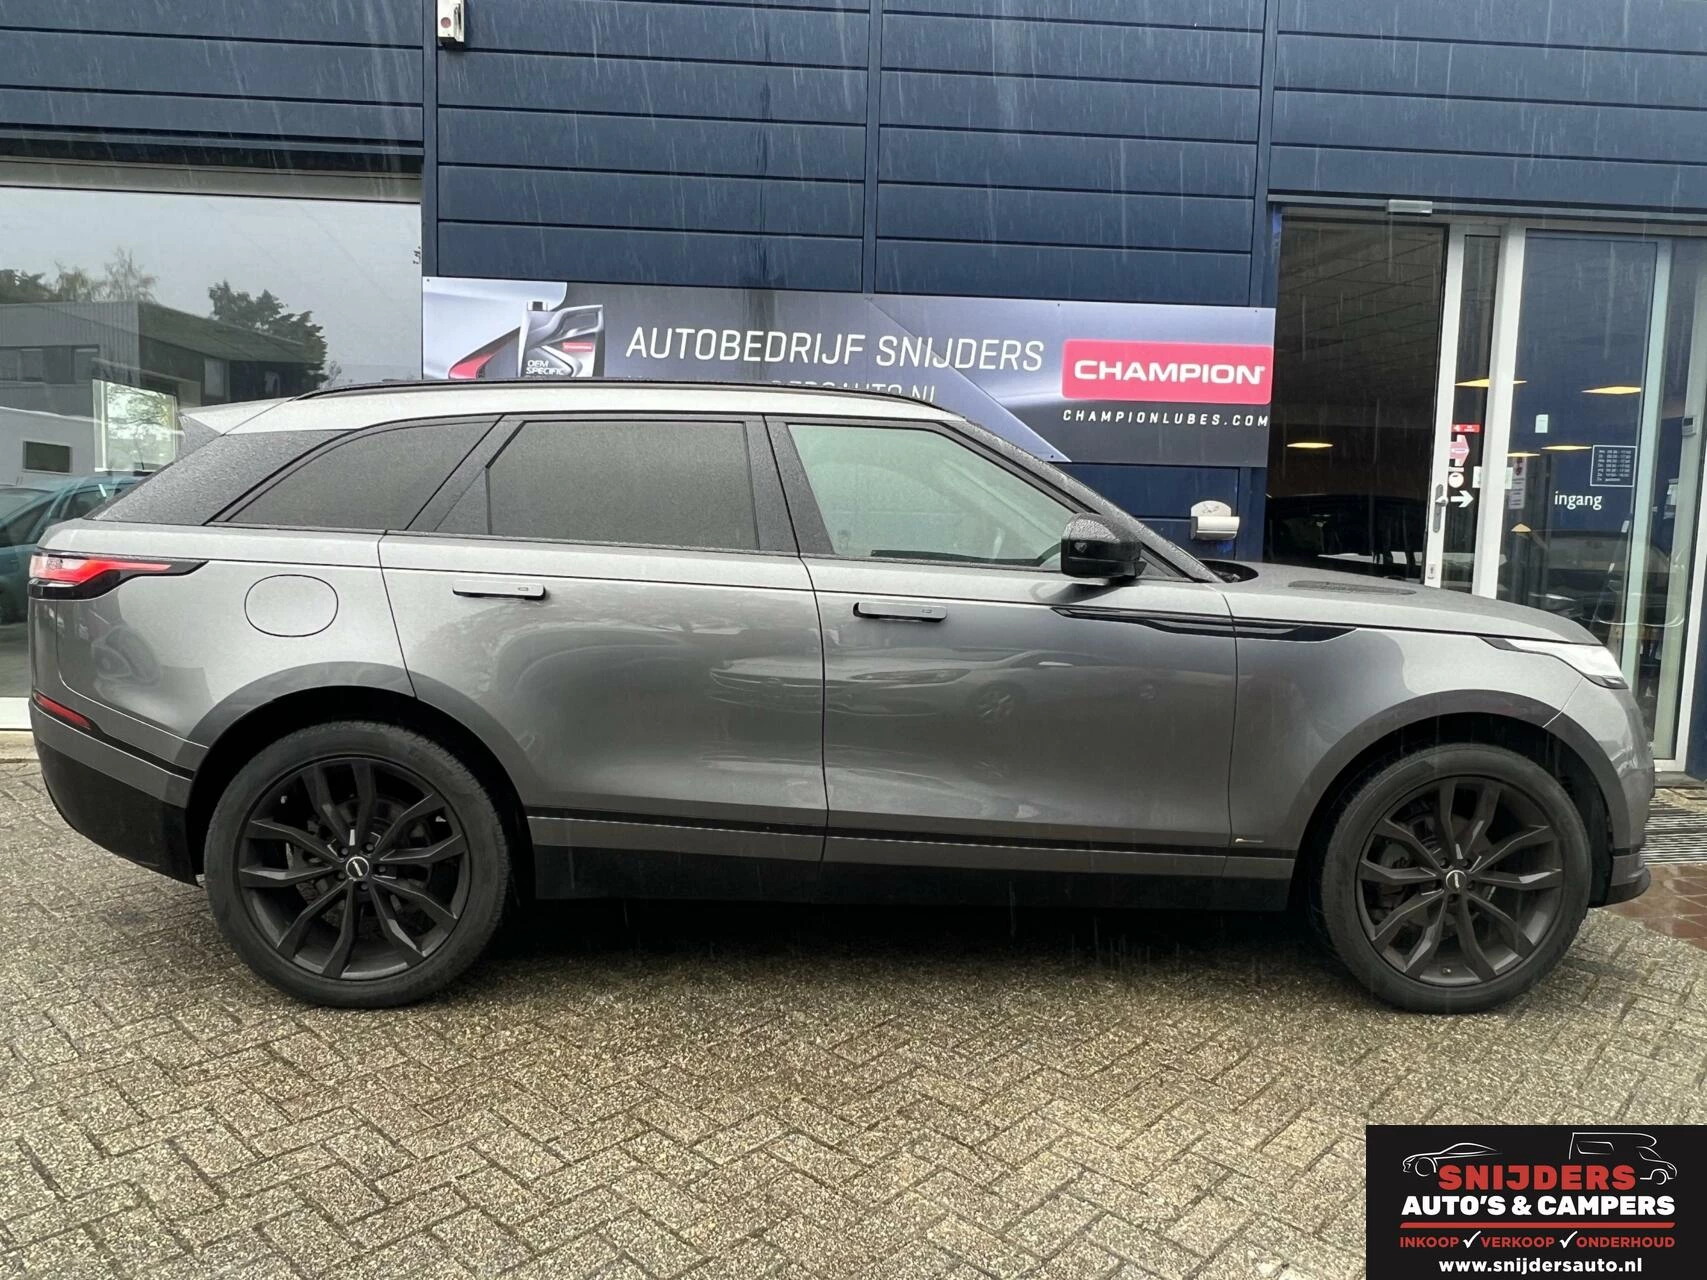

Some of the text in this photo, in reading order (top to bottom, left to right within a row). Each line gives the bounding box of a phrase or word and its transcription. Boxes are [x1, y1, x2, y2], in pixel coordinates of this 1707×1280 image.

[625, 326, 1045, 371] AUTOBEDRIJF SNIJDERS
[1074, 359, 1262, 385] CHAMPION
[1062, 409, 1269, 427] CHAMPIONLUBES.COM
[1554, 490, 1602, 510] ingang
